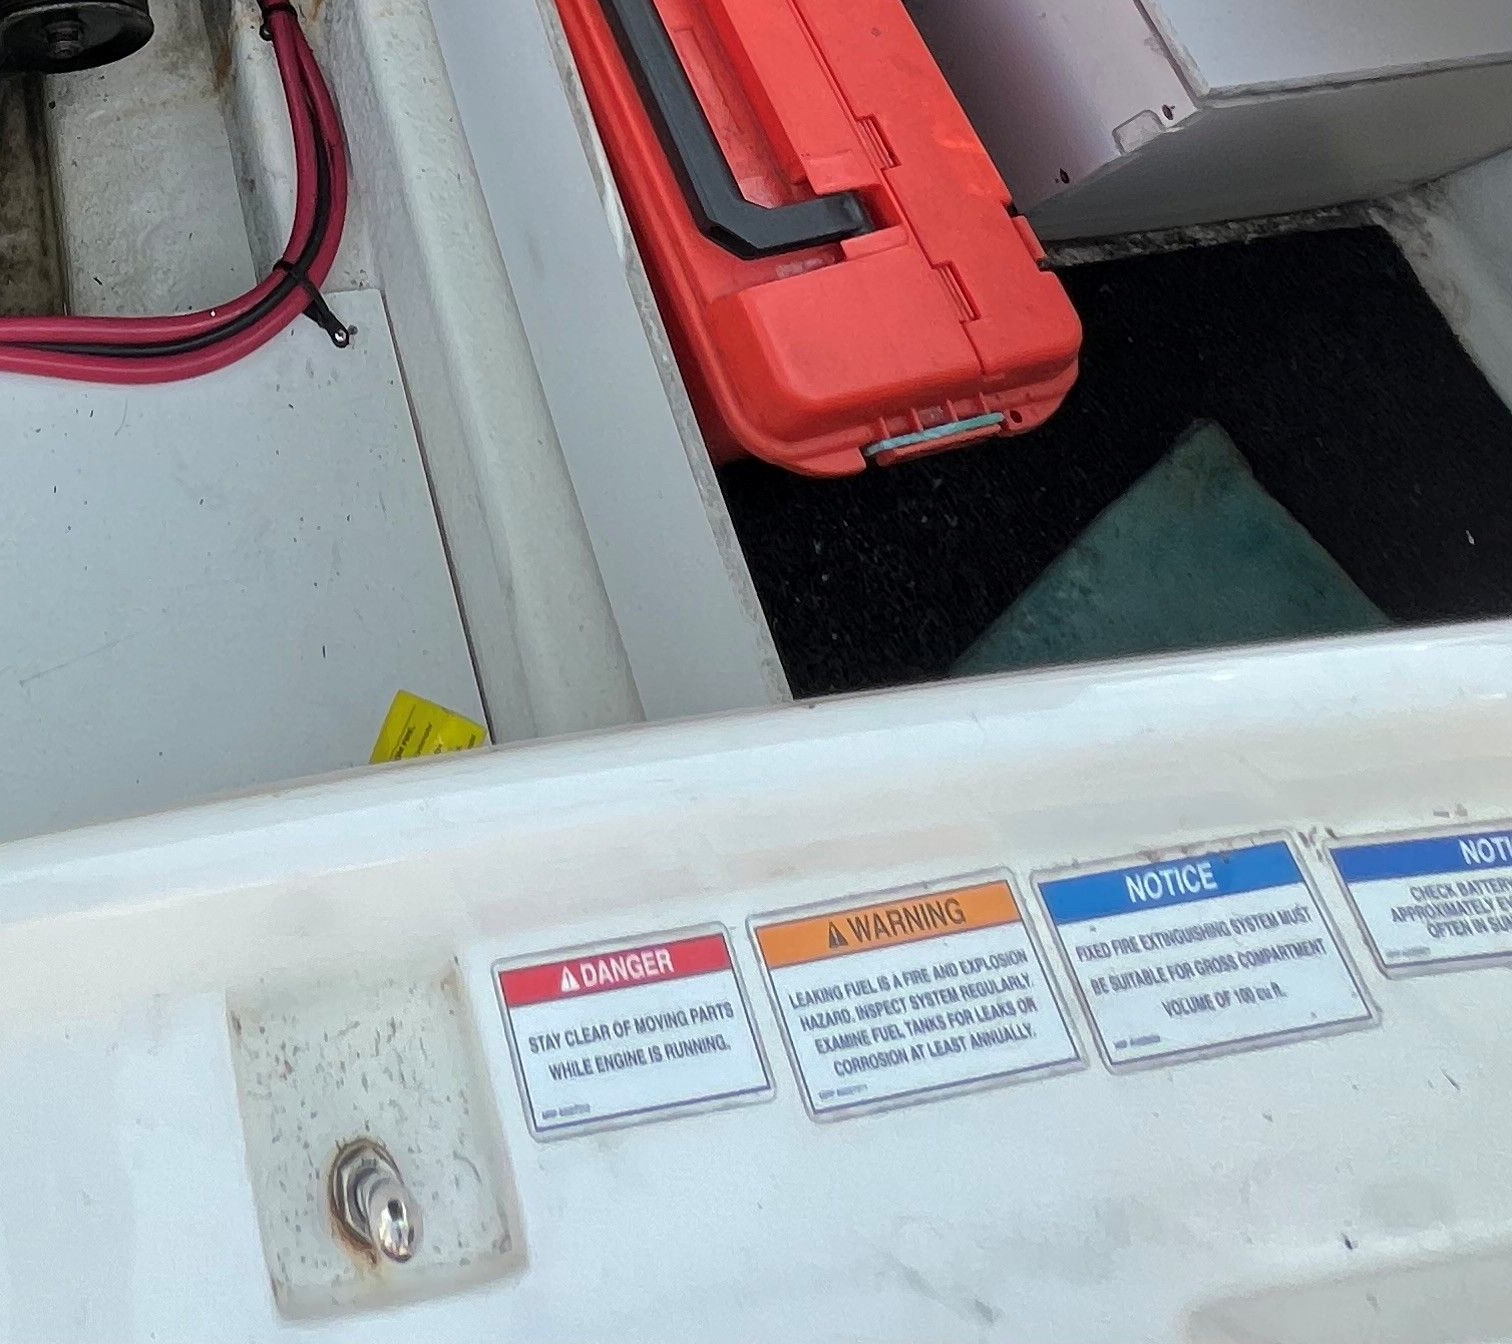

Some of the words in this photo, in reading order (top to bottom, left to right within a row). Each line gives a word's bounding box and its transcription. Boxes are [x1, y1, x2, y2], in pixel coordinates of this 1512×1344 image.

[1125, 862, 1219, 904] NOTICE
[847, 899, 966, 943] WARNING
[1075, 939, 1112, 962] FIXED
[1111, 935, 1140, 956] FIRE
[1140, 919, 1232, 951] EXTINGUISHING
[1230, 911, 1279, 935] SYSTEM
[1276, 906, 1313, 925] MUST
[1427, 919, 1474, 939] OFTEN
[580, 948, 675, 989] DANGER
[789, 983, 844, 1010] LEAKING
[844, 976, 878, 999] FUEL
[877, 974, 890, 993] IS
[892, 971, 904, 990] A
[903, 967, 932, 989] FIRE
[933, 962, 959, 984] AND
[961, 948, 1028, 976] EXPLOSION
[1090, 977, 1110, 996] BE
[1110, 964, 1169, 992] SUITABLE
[1169, 959, 1196, 982] FOR
[1195, 952, 1239, 975] GROSS
[1238, 937, 1328, 970] COMPARTMENT
[855, 995, 908, 1021] INSPECT
[909, 985, 959, 1011] SYSTEM
[1161, 989, 1214, 1019] VOLUME
[1214, 988, 1232, 1008] OF
[528, 1032, 562, 1055] STAY
[564, 1024, 611, 1048] CLEAR
[614, 1019, 632, 1039] OF
[634, 1010, 689, 1035] MOVING
[690, 1001, 735, 1025] PARTS
[815, 1028, 871, 1054] EXAMINE
[872, 1021, 906, 1043] FUEL
[905, 1013, 946, 1036] TANKS
[948, 1007, 975, 1028] FOR
[975, 1000, 1016, 1022] LEAKS
[1018, 996, 1038, 1013] OR
[549, 1057, 594, 1081] WHILE
[595, 1048, 648, 1074] ENGINE
[648, 1045, 663, 1064] IS
[833, 1046, 909, 1077] CORROSION
[910, 1043, 928, 1061] AT
[928, 1035, 968, 1058] LEAST
